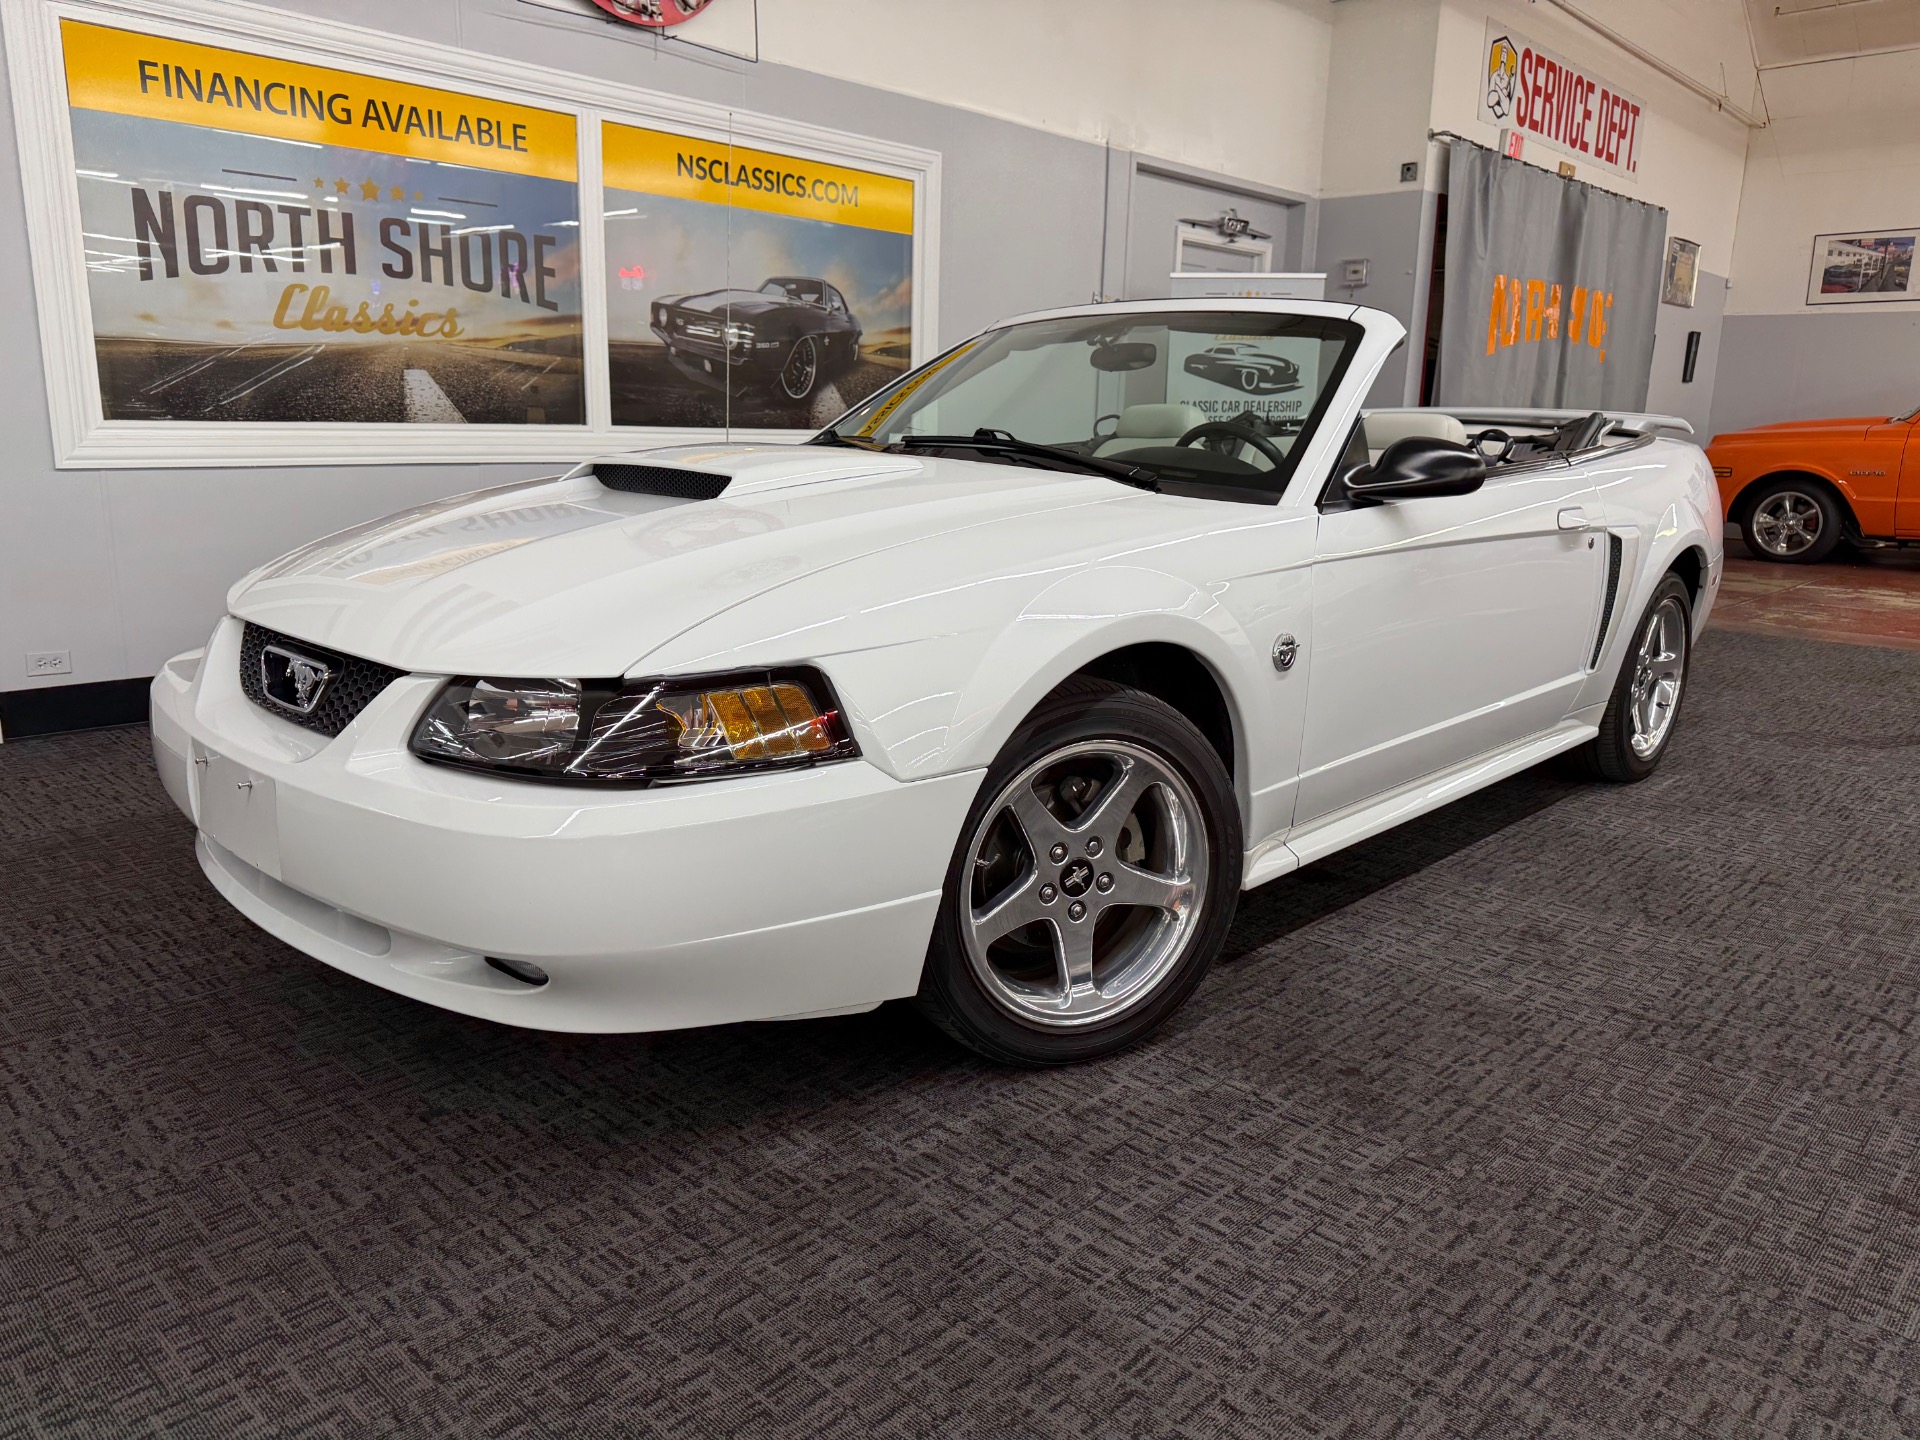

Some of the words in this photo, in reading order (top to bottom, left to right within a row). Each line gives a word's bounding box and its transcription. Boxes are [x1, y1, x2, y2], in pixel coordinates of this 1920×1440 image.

[138, 59, 352, 125] FINANCING
[362, 98, 528, 152] AVAILABLE
[1516, 47, 1595, 154] SERVICE
[1594, 88, 1640, 173] DEPT.
[677, 152, 859, 207] NSCLASSICS.COM
[131, 187, 357, 281] NORTH
[379, 217, 558, 312] SHORE
[272, 283, 464, 338] Classics
[1221, 401, 1240, 413] CAR
[1243, 401, 1302, 413] DEALERSHIP
